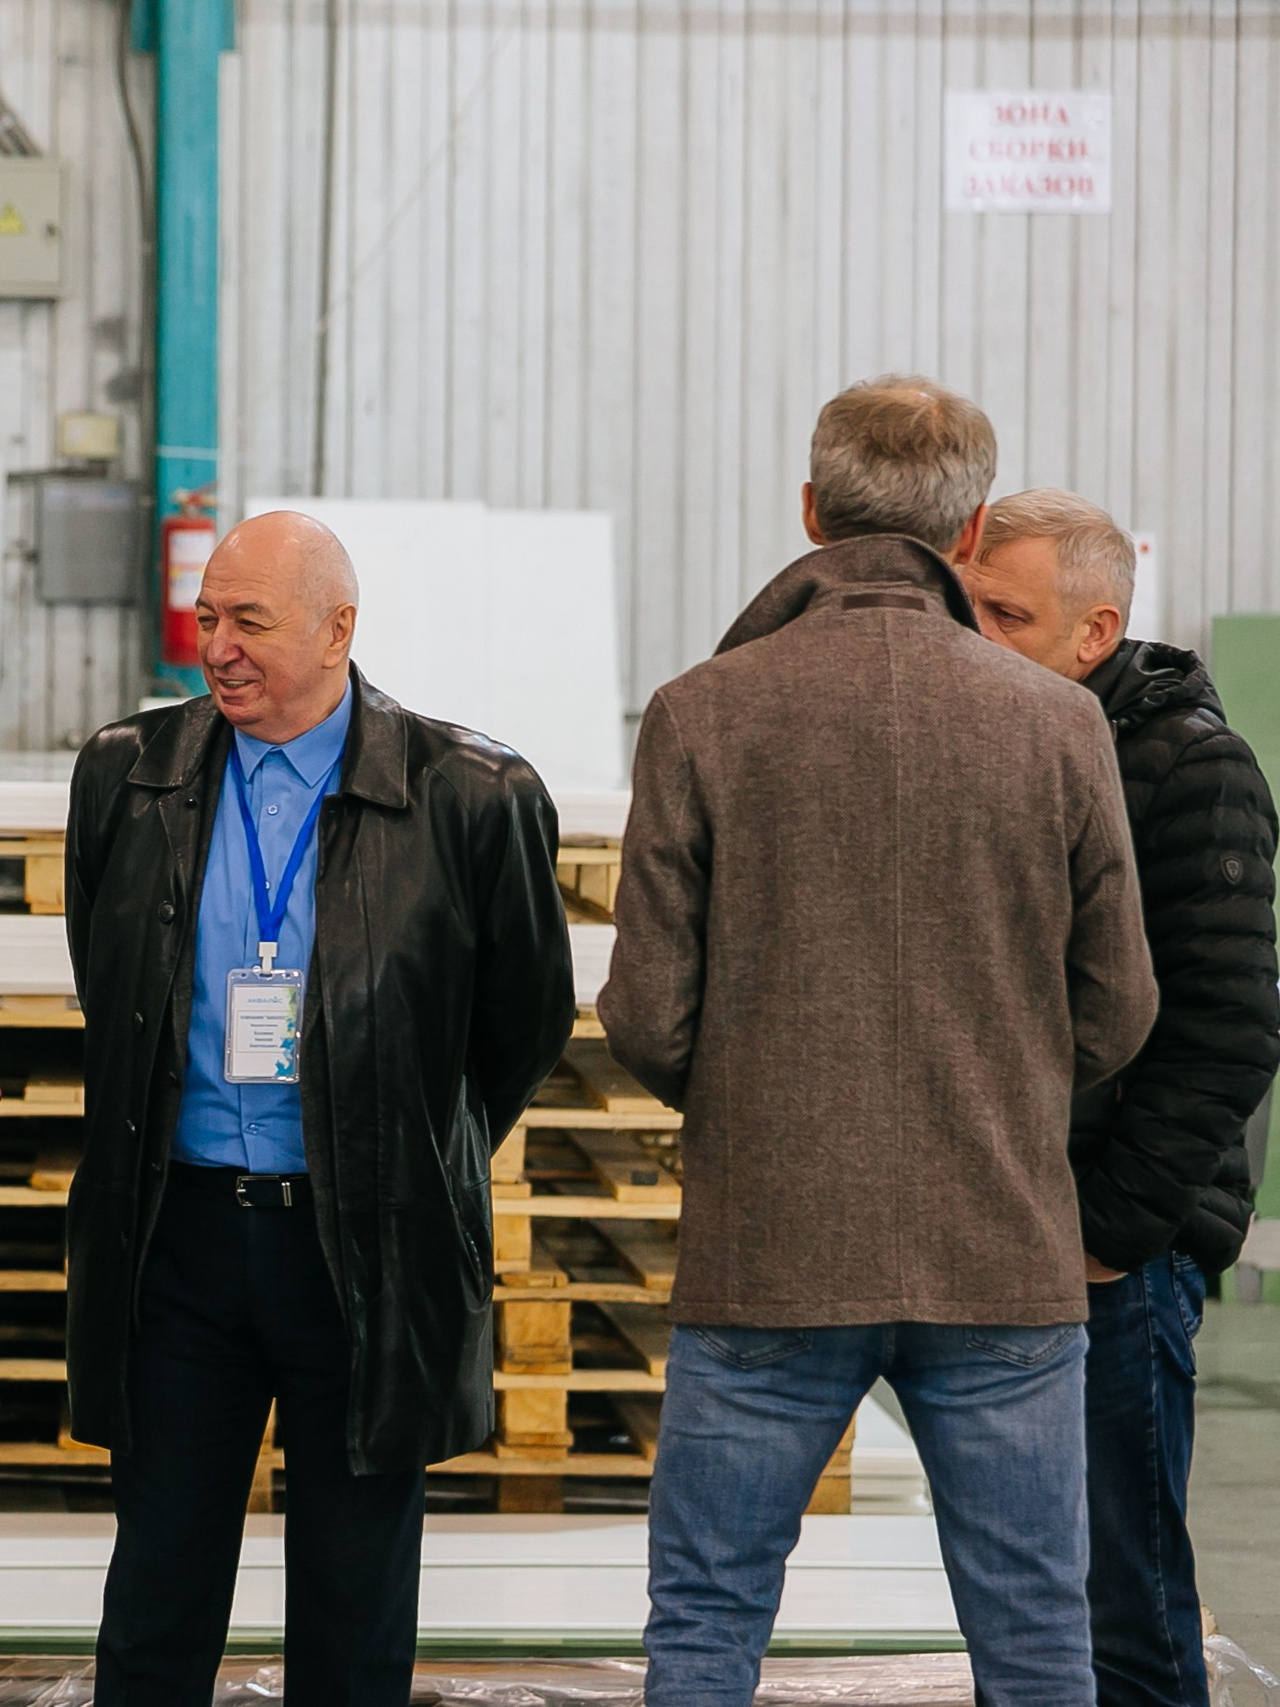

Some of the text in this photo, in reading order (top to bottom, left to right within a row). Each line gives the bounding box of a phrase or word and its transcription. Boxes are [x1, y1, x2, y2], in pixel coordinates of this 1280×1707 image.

[992, 103, 1071, 126] ЗОНА
[966, 137, 1089, 160] СБОРКИ
[965, 173, 1096, 196] ЗАКАЗОВ
